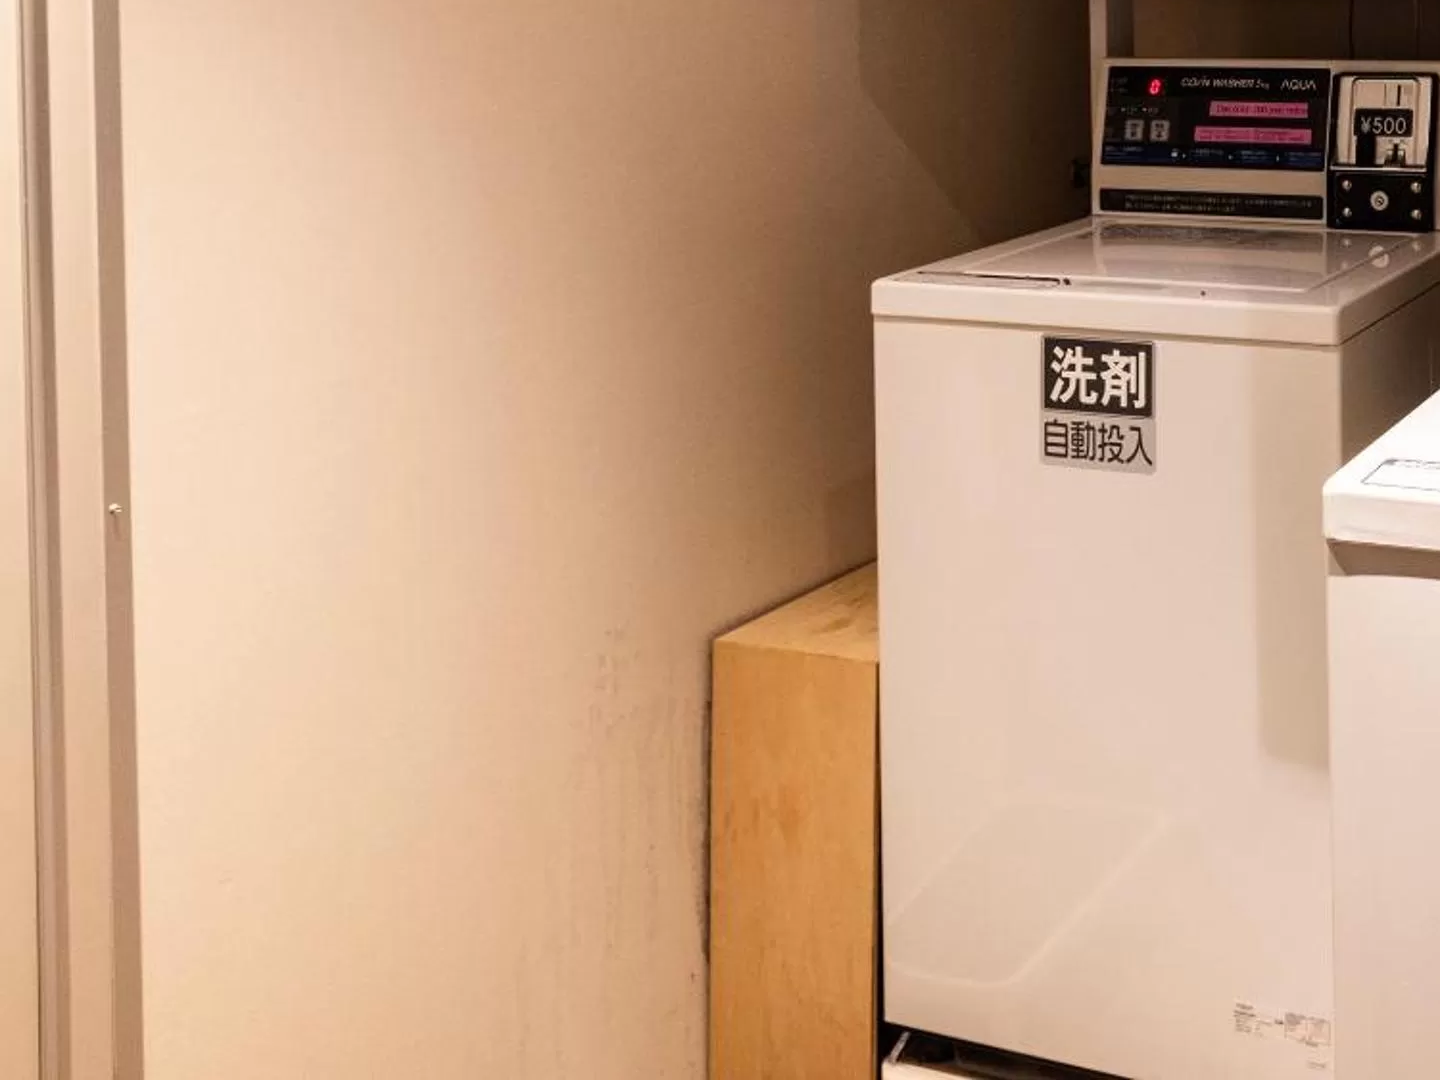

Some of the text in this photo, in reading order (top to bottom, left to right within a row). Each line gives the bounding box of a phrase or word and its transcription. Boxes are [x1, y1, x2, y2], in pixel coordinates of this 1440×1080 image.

[1280, 79, 1317, 90] AQUA
[1361, 117, 1407, 134] ¥500
[1050, 346, 1146, 409] 洗剤
[1043, 418, 1153, 466] 自動投入
